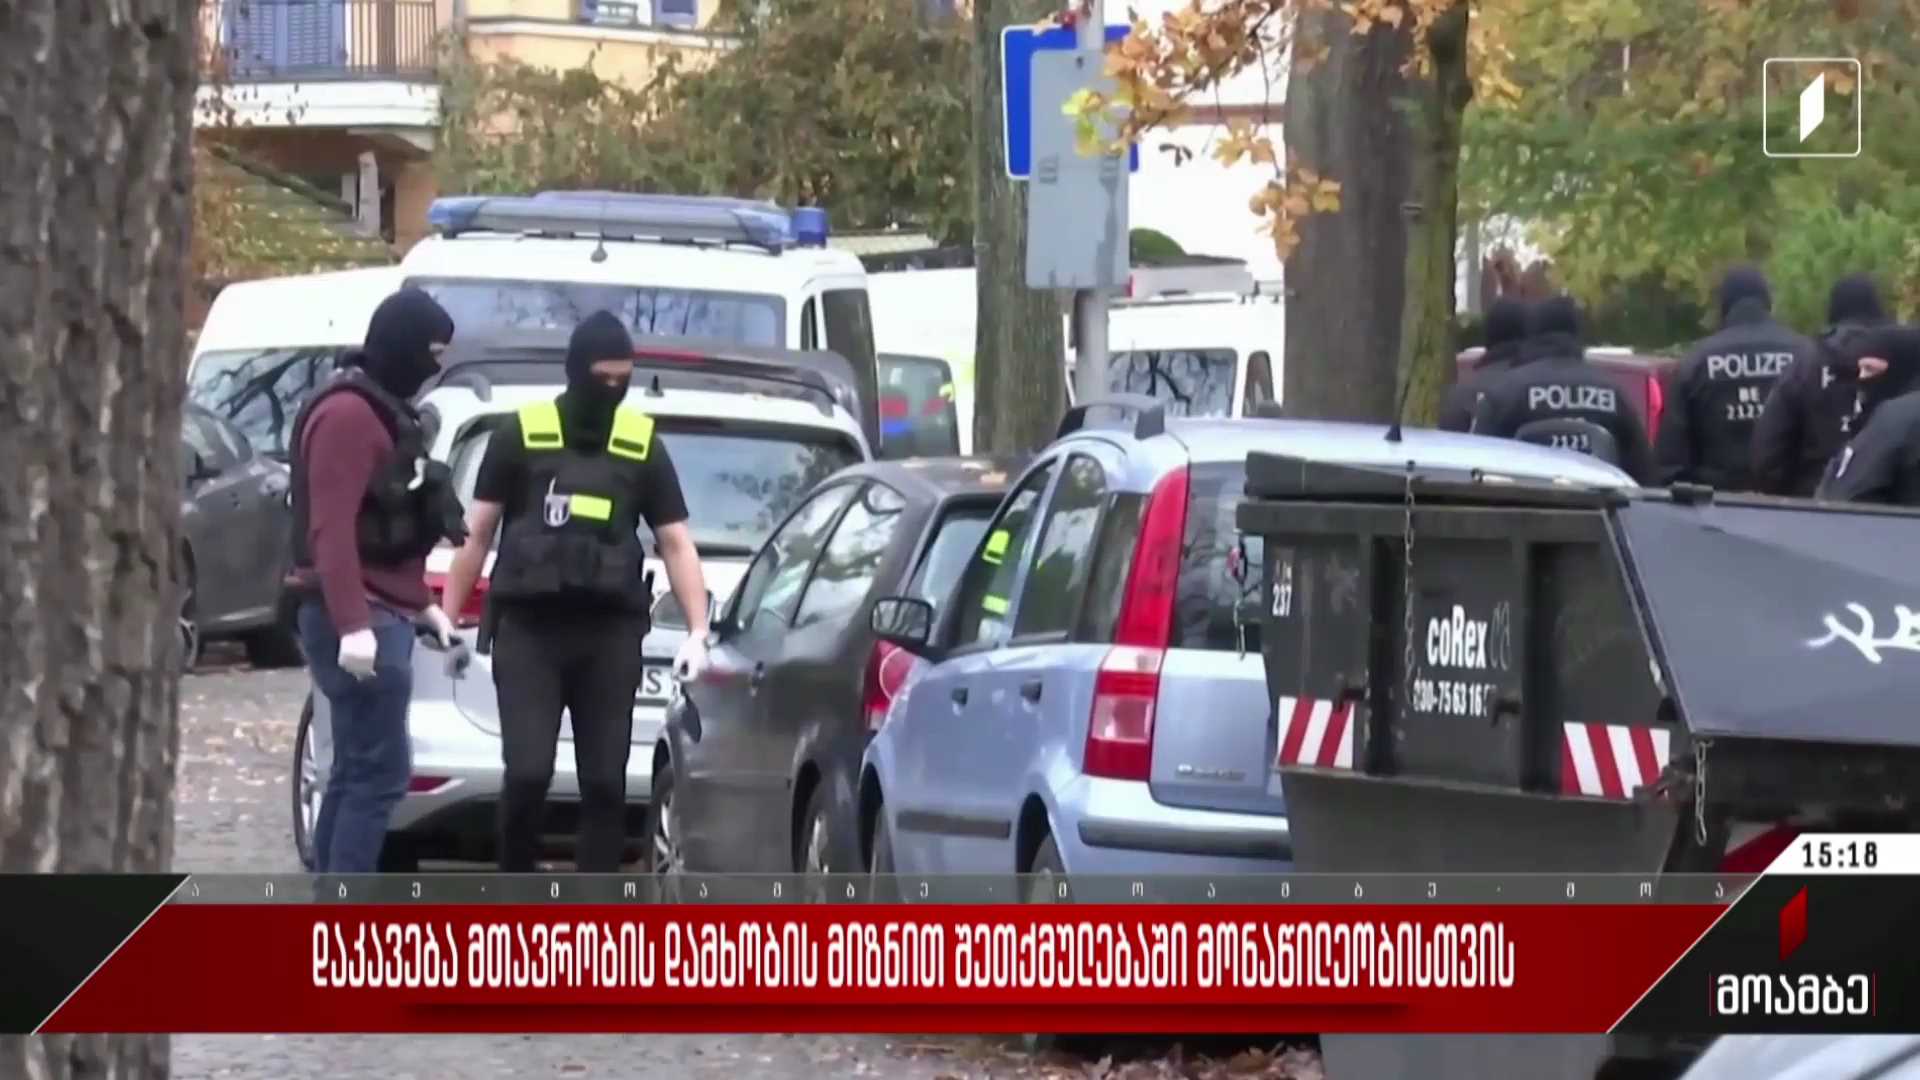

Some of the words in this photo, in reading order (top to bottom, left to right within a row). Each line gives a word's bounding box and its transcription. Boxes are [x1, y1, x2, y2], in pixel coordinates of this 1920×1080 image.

[1707, 353, 1793, 379] POLIZE
[1529, 384, 1615, 412] POLIZEI
[1272, 583, 1292, 616] 237
[1426, 604, 1488, 669] coRex
